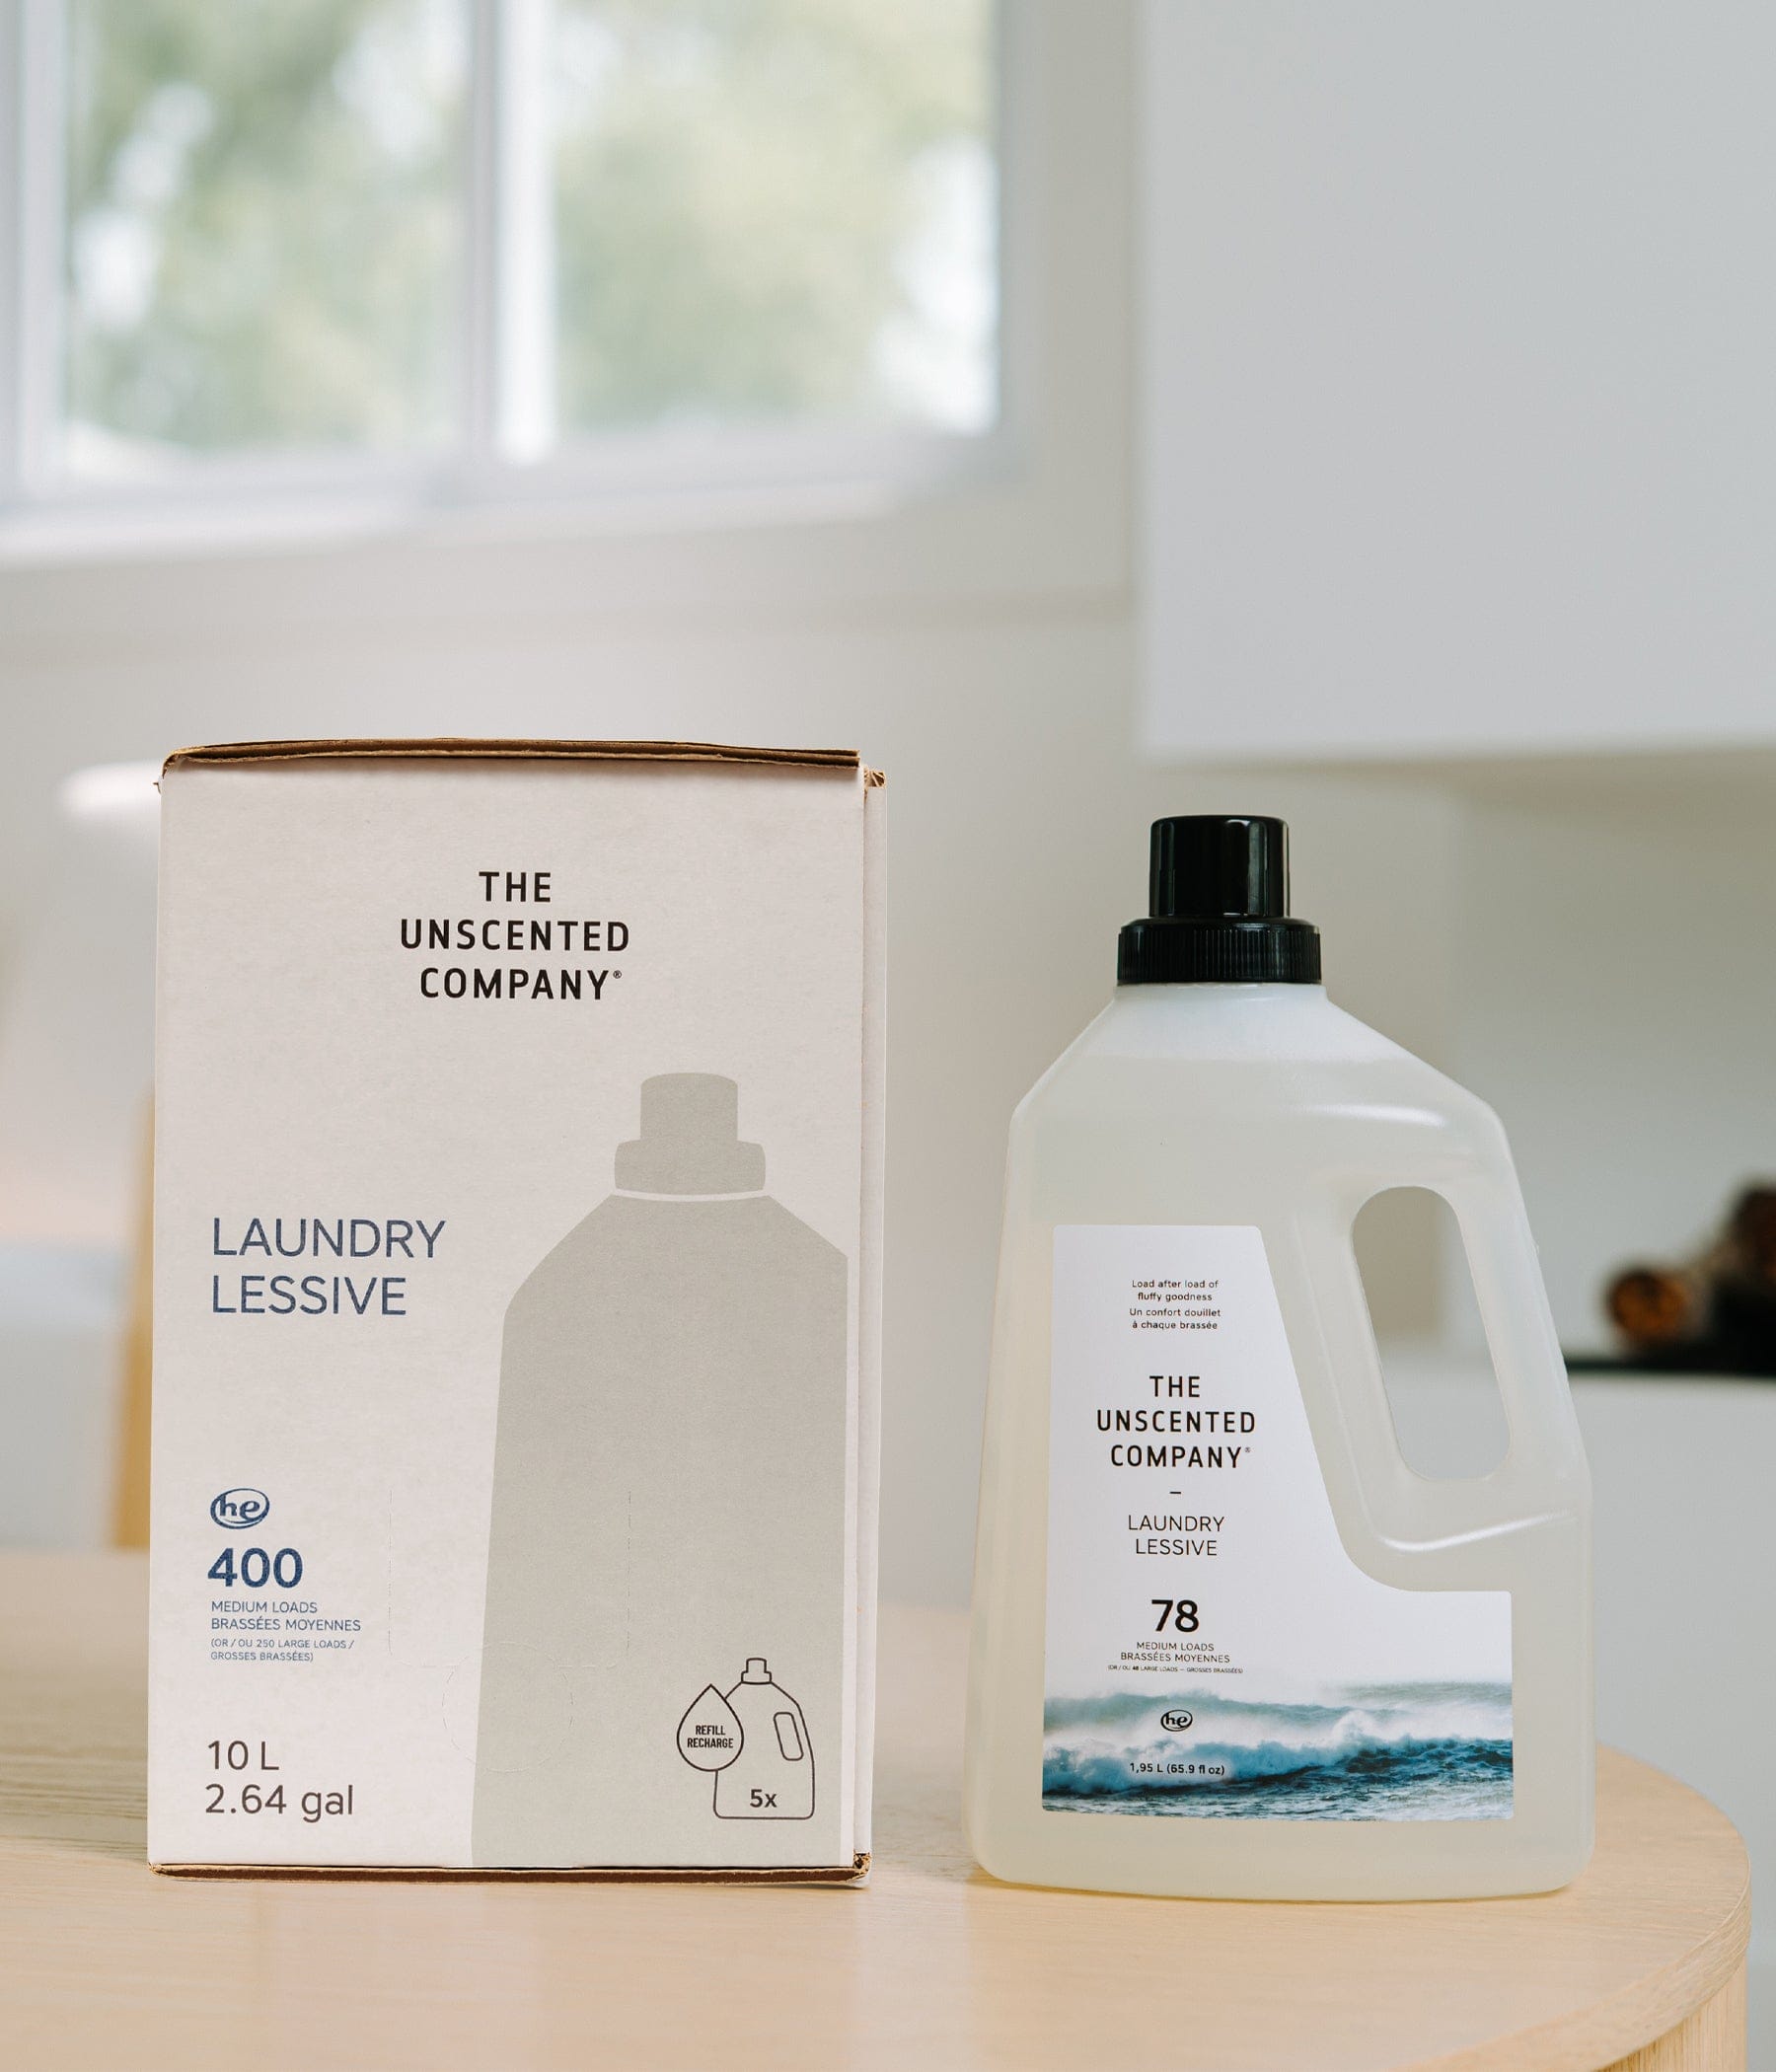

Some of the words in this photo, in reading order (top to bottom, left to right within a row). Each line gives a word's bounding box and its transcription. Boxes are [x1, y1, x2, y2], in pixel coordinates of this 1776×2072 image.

[479, 871, 552, 902] THE
[401, 919, 629, 951] UNSCENTED
[213, 1218, 447, 1258] LAUNDRY
[1132, 1280, 1154, 1289] Load
[1157, 1280, 1182, 1289] after
[1184, 1280, 1206, 1289] load
[1208, 1280, 1220, 1289] of
[212, 1275, 407, 1315] LESSIVE
[1138, 1292, 1162, 1301] fluffy
[1165, 1293, 1213, 1302] goodness
[1146, 1308, 1181, 1317] confort
[1184, 1308, 1221, 1317] douillet
[1132, 1320, 1138, 1329] à
[1141, 1320, 1176, 1331] chaque
[1179, 1320, 1218, 1330] brassée
[1149, 1375, 1201, 1397] THE
[1097, 1409, 1255, 1433] UNSCENTED
[215, 1491, 263, 1524] he
[1128, 1515, 1225, 1531] LAUNDRY
[1136, 1538, 1218, 1556] LESSIVE
[207, 1547, 304, 1589] 400
[211, 1600, 267, 1612] MEDIUM
[272, 1601, 318, 1613] LOADS
[211, 1616, 281, 1630] BRASSÉES
[285, 1619, 361, 1631] MOYENNES
[1151, 1598, 1200, 1633] 78
[210, 1638, 229, 1648] (OR
[238, 1639, 253, 1648] OU
[256, 1639, 275, 1648] 250
[277, 1639, 311, 1648] LARGE
[313, 1640, 346, 1649] LOADS
[1136, 1642, 1177, 1651] MEDIUM
[1180, 1643, 1215, 1652] LOADS
[210, 1651, 257, 1661] GROSSES
[259, 1651, 314, 1663] BRASSÉES)
[1121, 1651, 1171, 1662] BRASSÉES
[1174, 1654, 1230, 1664] MOYENNES
[1164, 1712, 1189, 1729] he
[695, 1725, 726, 1736] REFILL
[687, 1738, 734, 1748] RECHARGE
[207, 1739, 249, 1771] 10
[260, 1740, 280, 1771] L
[1130, 1762, 1153, 1773] 1,95
[1156, 1763, 1163, 1773] L
[1166, 1763, 1195, 1774] (65.9
[1198, 1764, 1206, 1774] fl
[1208, 1764, 1224, 1775] oz)
[205, 1783, 287, 1814] 2.64
[301, 1784, 353, 1823] gal
[750, 1789, 777, 1809] 5x
